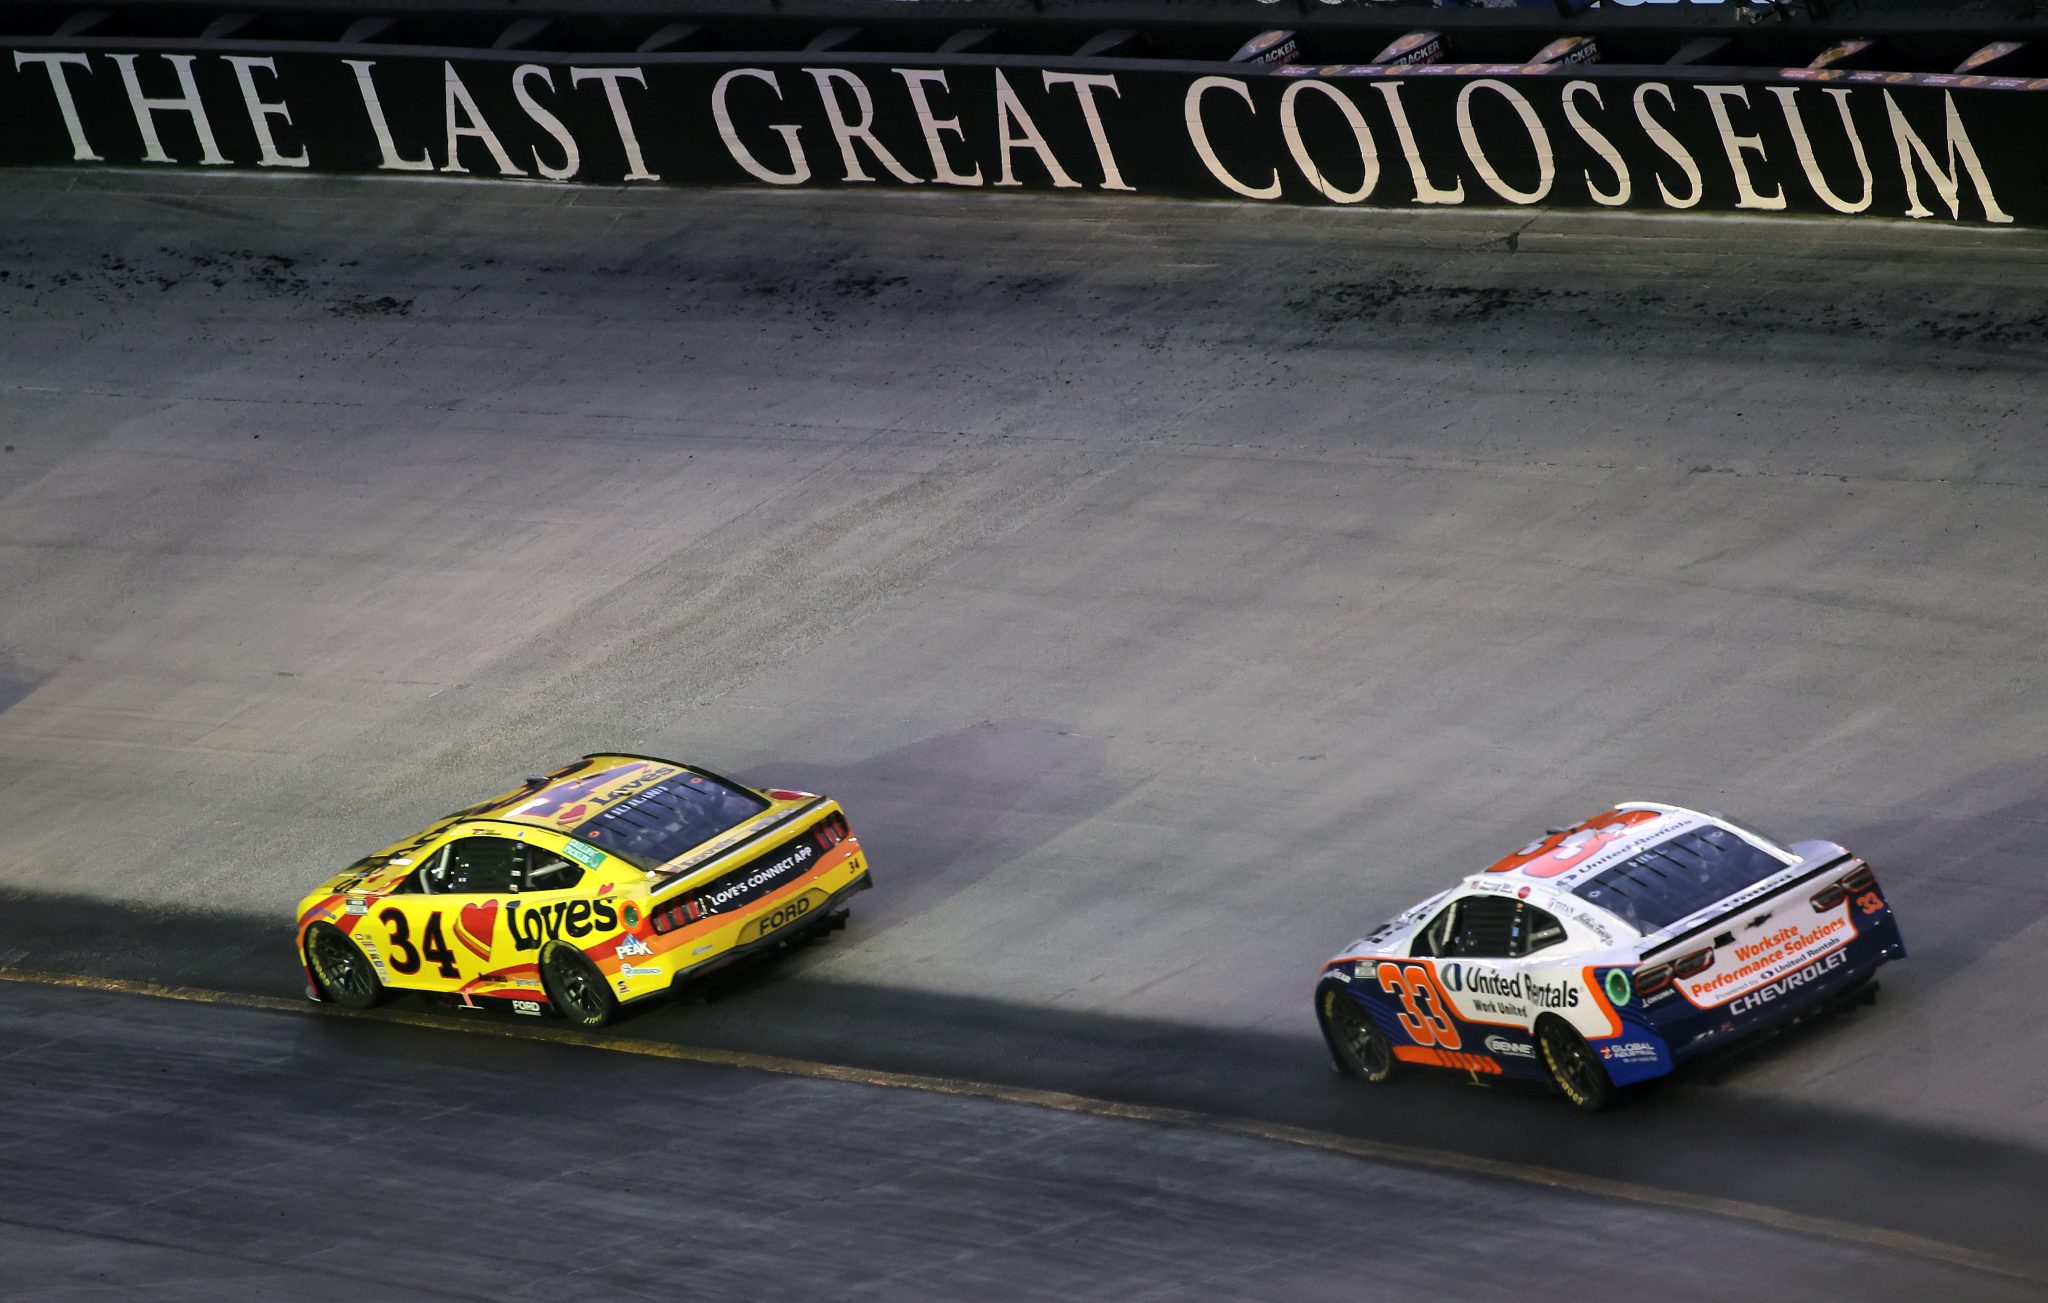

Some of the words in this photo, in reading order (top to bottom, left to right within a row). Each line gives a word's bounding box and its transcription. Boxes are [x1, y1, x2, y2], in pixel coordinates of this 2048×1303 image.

[1556, 42, 1598, 64] RACKER
[14, 51, 309, 167] THE
[342, 60, 660, 183] LAST
[712, 68, 1136, 191] GREAT
[1185, 76, 2013, 222] COLOSSEUM
[711, 881, 748, 906] LOVE'S
[747, 857, 796, 888] CONNECT
[794, 846, 813, 865] APP
[848, 858, 860, 874] 34
[1578, 844, 1633, 874] United
[759, 897, 811, 935] FORD
[1856, 891, 1885, 915] 33
[379, 907, 462, 980] 34
[615, 941, 654, 960] PEAK
[1691, 949, 1784, 998] Performance
[1784, 917, 1847, 955] Solutions
[1734, 925, 1800, 962] Worksite
[1773, 954, 1808, 974] United
[1806, 937, 1841, 958] Rentals
[1466, 966, 1522, 999] United
[1524, 973, 1579, 1008] Rentals
[1729, 947, 1849, 1016] CHEVROLET
[512, 1000, 541, 1012] FORD
[1376, 962, 1462, 1050] 33
[1473, 999, 1496, 1013] Work
[1498, 1002, 1528, 1018] United
[1492, 1040, 1534, 1054] BENNE
